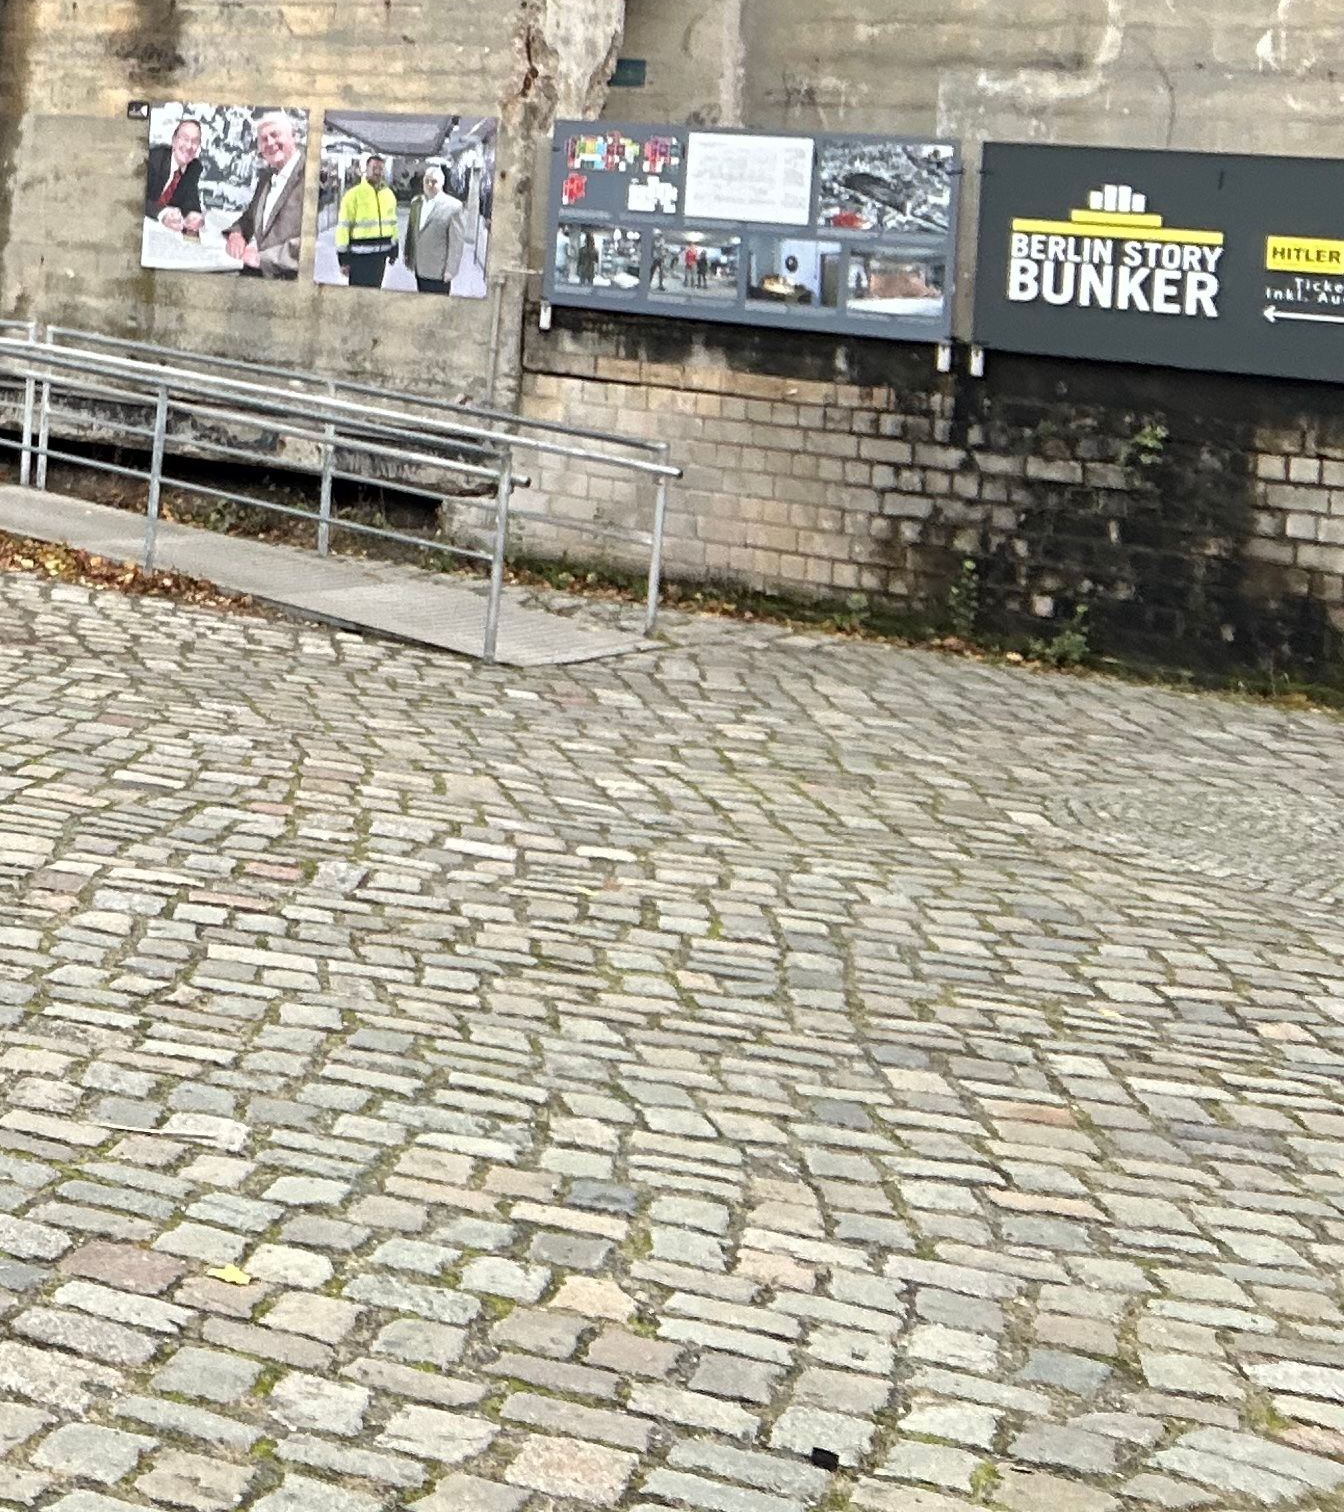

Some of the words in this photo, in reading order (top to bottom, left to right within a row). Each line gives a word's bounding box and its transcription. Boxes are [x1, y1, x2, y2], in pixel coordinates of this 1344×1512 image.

[1011, 232, 1113, 265] BERLIN
[1123, 244, 1223, 272] STORY
[1272, 246, 1341, 264] HITLER
[1008, 257, 1219, 318] BUNKER
[1317, 292, 1344, 306] Au
